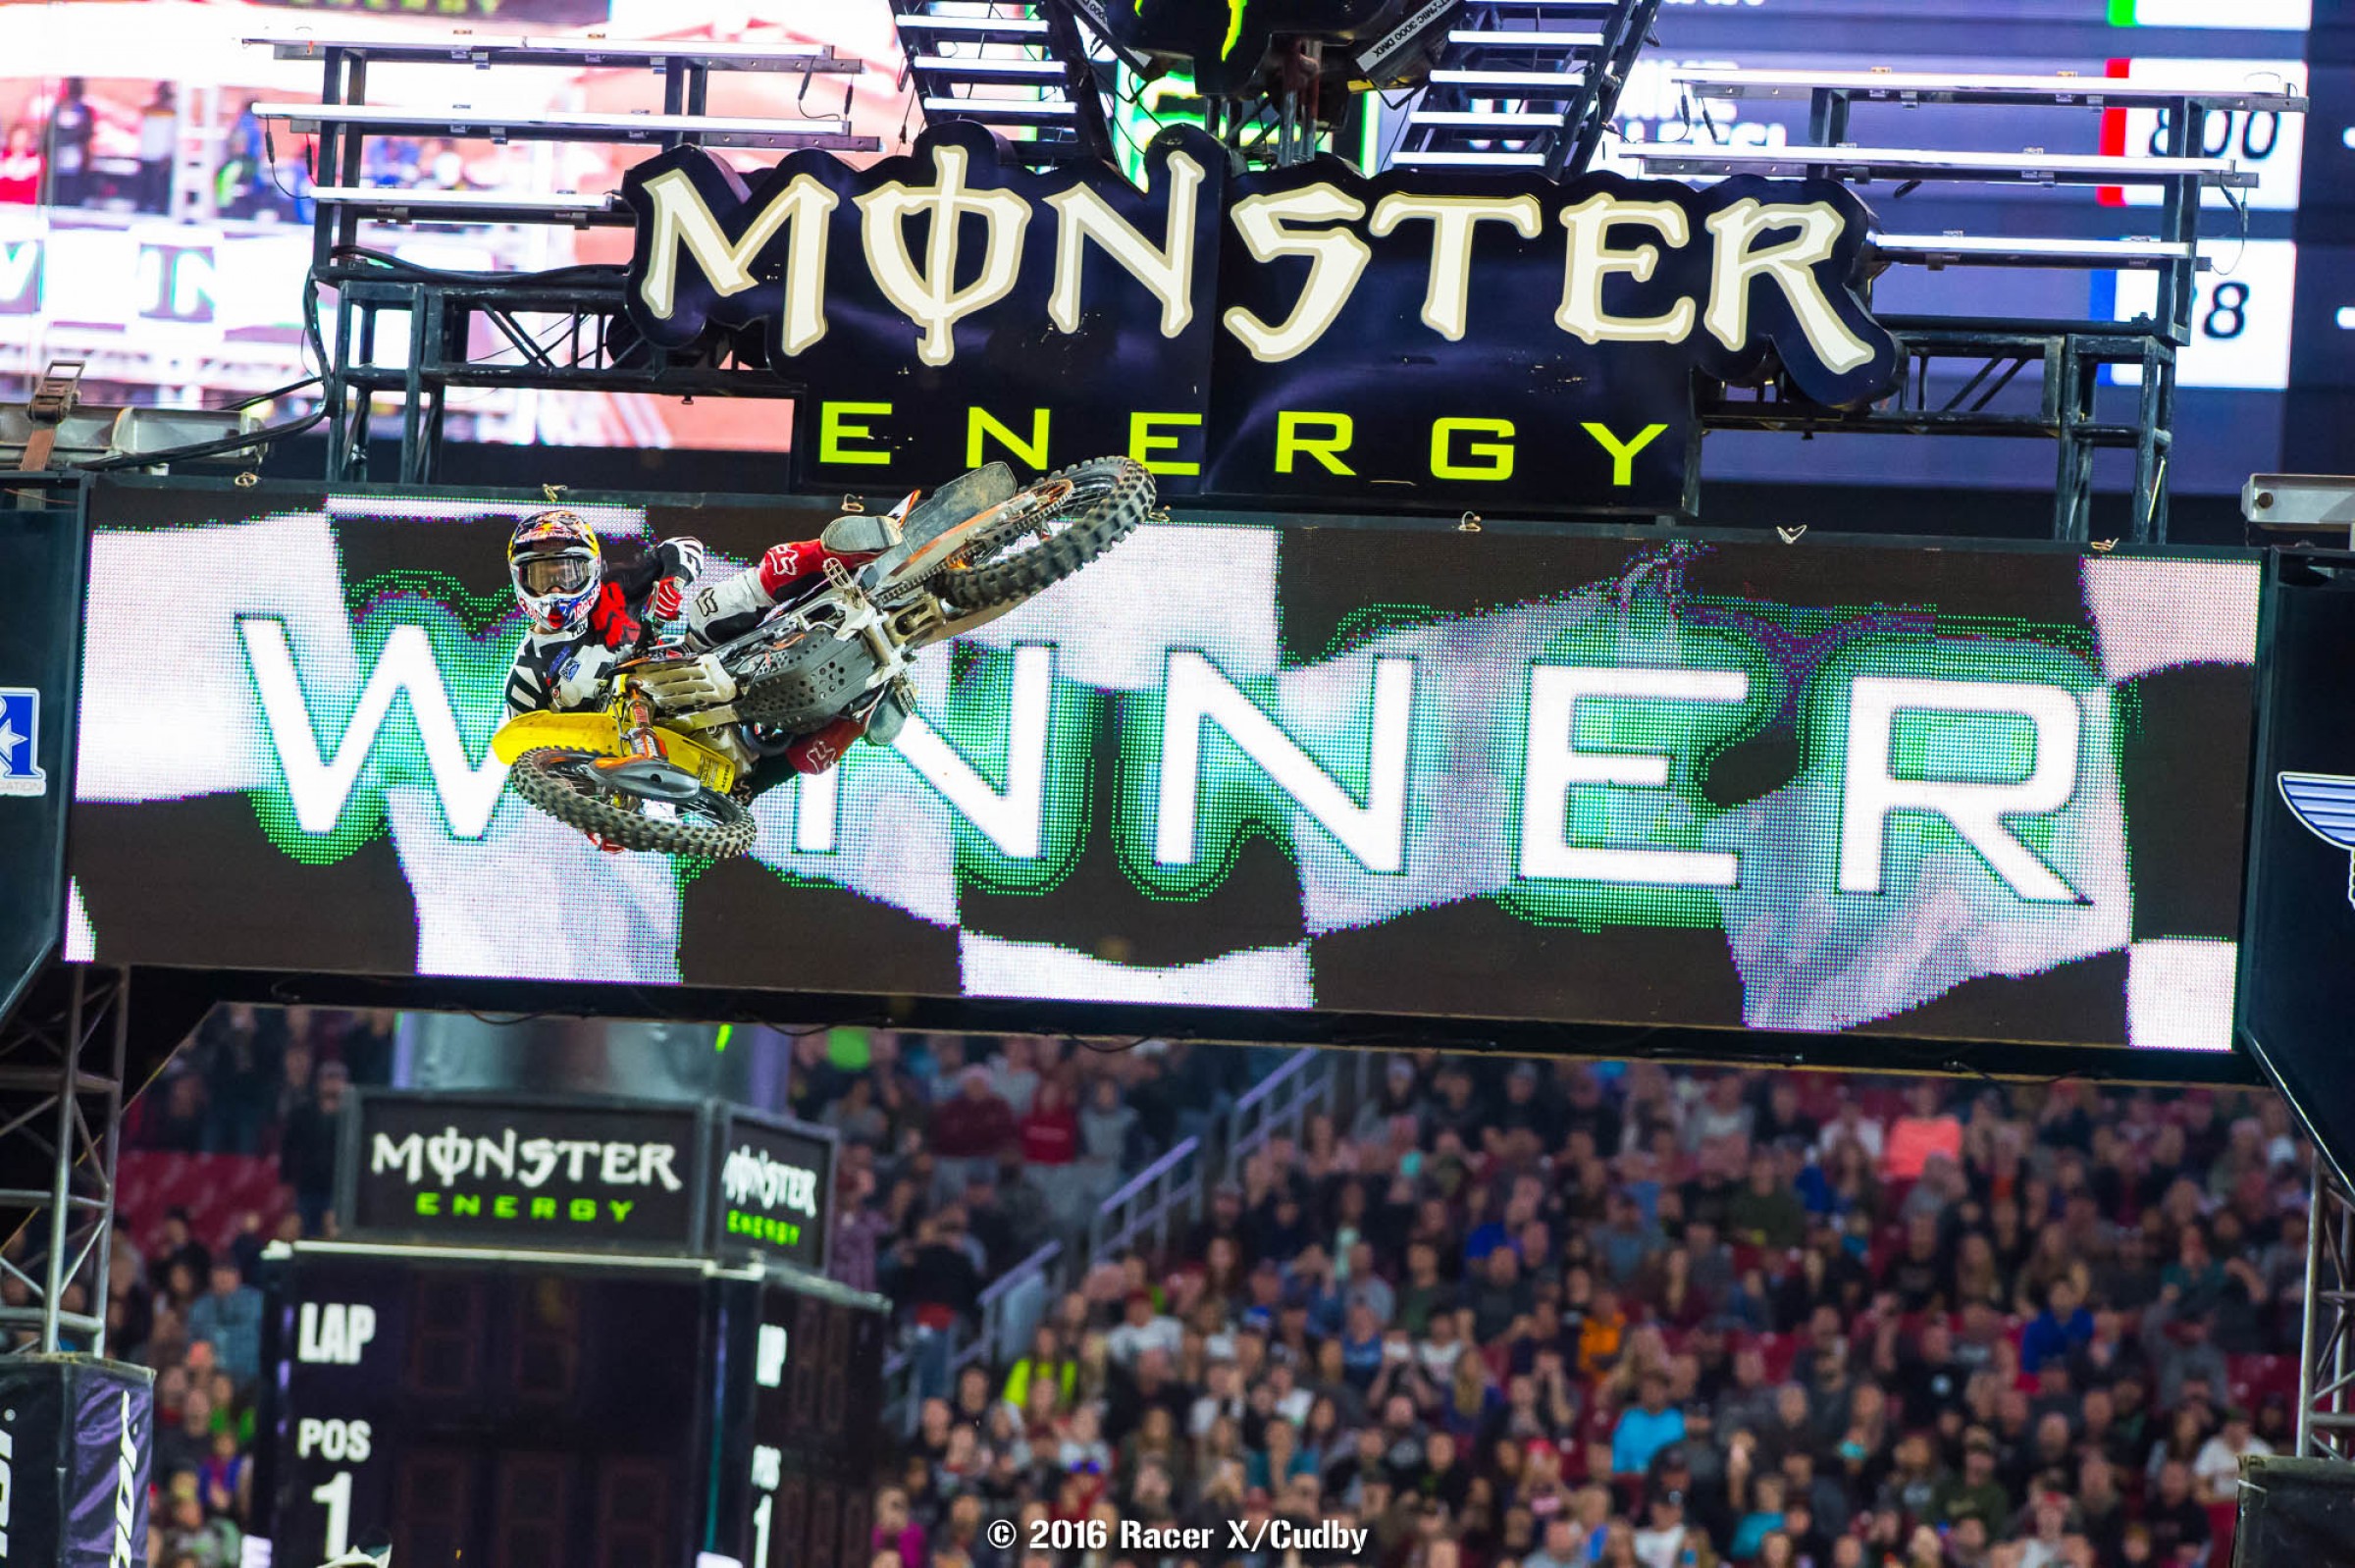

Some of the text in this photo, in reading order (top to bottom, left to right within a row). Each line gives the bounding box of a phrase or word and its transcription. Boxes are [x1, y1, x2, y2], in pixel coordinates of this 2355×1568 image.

[1373, 39, 1395, 58] DMX
[641, 145, 1875, 374] MONSTER
[2192, 282, 2250, 339] 8
[819, 401, 1668, 486] ENERGY
[236, 615, 2094, 905] WNNER
[371, 1125, 683, 1192] MONSTER
[415, 1191, 634, 1223] ENERGY
[298, 1302, 376, 1364] LAP
[298, 1419, 372, 1462] POS
[312, 1471, 352, 1561] 1
